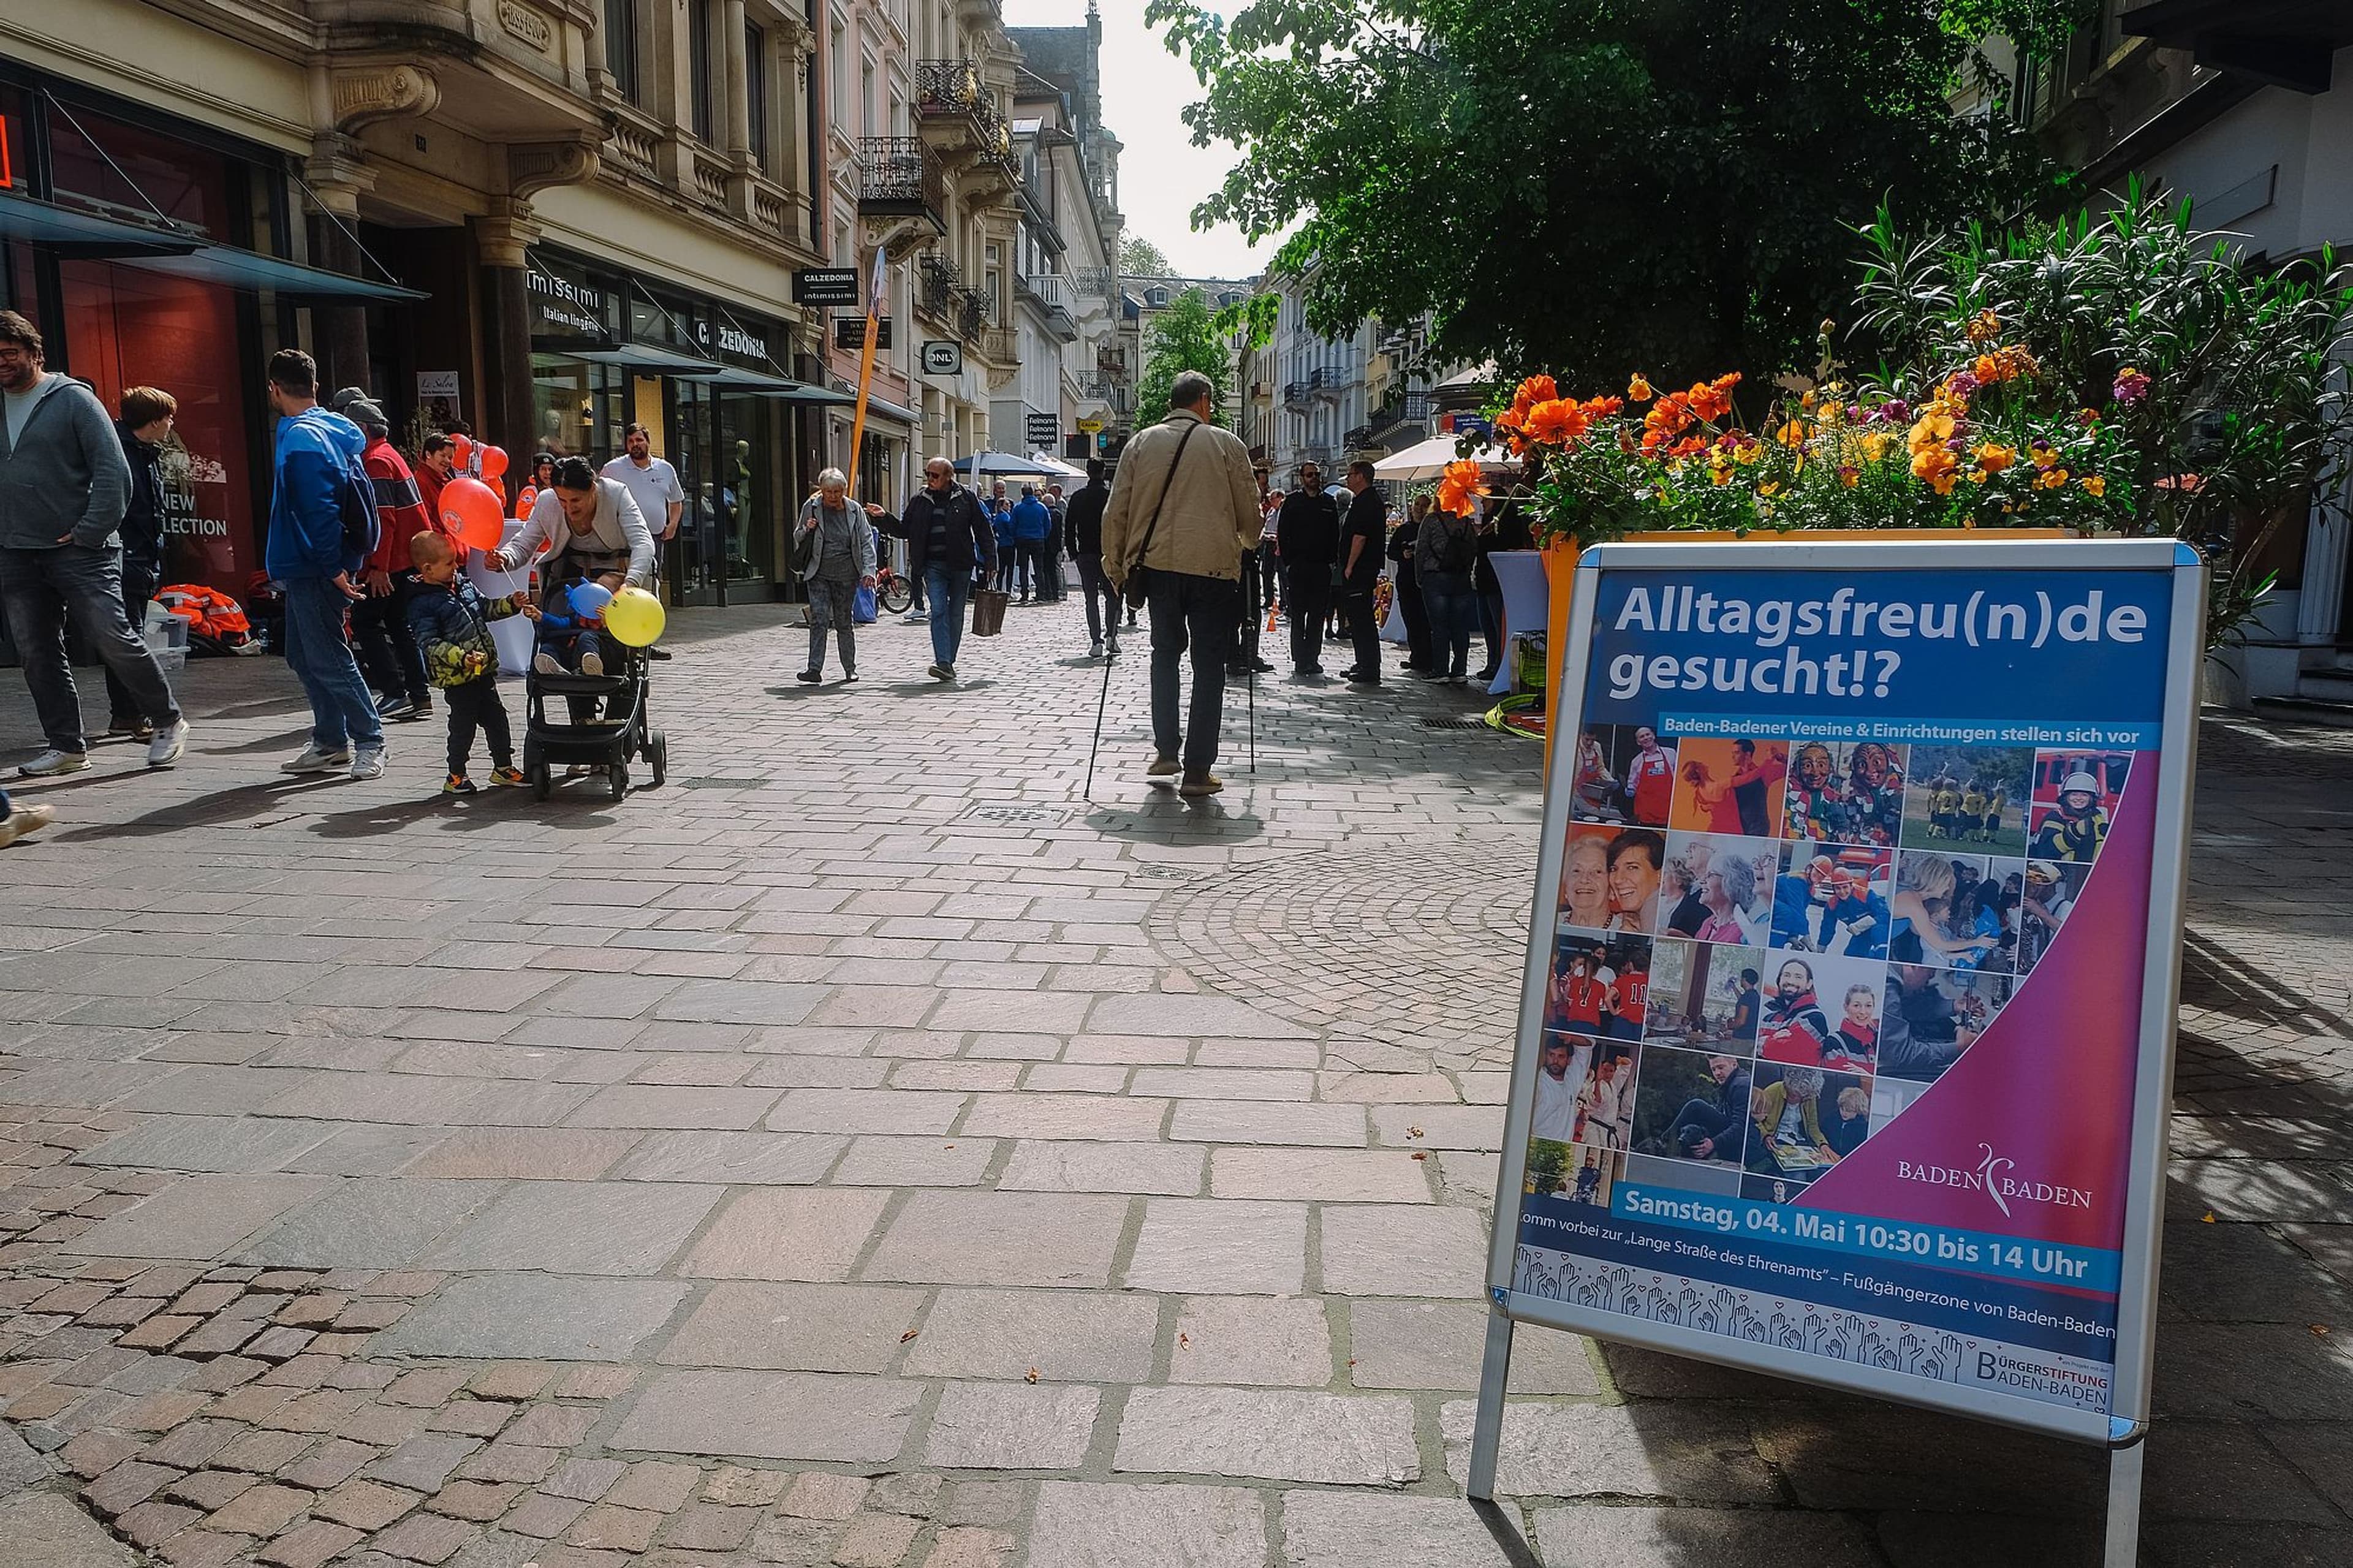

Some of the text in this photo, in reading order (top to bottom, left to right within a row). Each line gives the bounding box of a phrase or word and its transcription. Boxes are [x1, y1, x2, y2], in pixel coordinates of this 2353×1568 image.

[543, 306, 569, 324] Italian
[699, 322, 767, 360] CZEDONIA
[927, 354, 957, 362] ONLY
[163, 493, 195, 511] NEW
[162, 517, 227, 536] LECTION
[1614, 586, 2147, 648] Alltagsfreu(n)de
[1609, 646, 1901, 700] gesucht!?
[1665, 718, 2140, 743] Baden-Badener Vereine & Einrichtungen stellen sich vor
[1897, 1161, 2093, 1208] BADEN BADEN
[1624, 1190, 2088, 1279] Samstag, 04. Mai 10:30 bis 14 Uhr
[1559, 1220, 1599, 1237] vorbei
[1602, 1229, 1623, 1242] zur
[1673, 1240, 1717, 1260] Straße
[1719, 1249, 1745, 1267] des
[1843, 1272, 1969, 1311] Fußgängerzone
[1974, 1301, 2003, 1317] von
[2007, 1305, 2116, 1339] Baden-Baden
[1976, 1351, 2108, 1389] BÜRGERSTIFTUNG
[2071, 1361, 2090, 1369] Projekt
